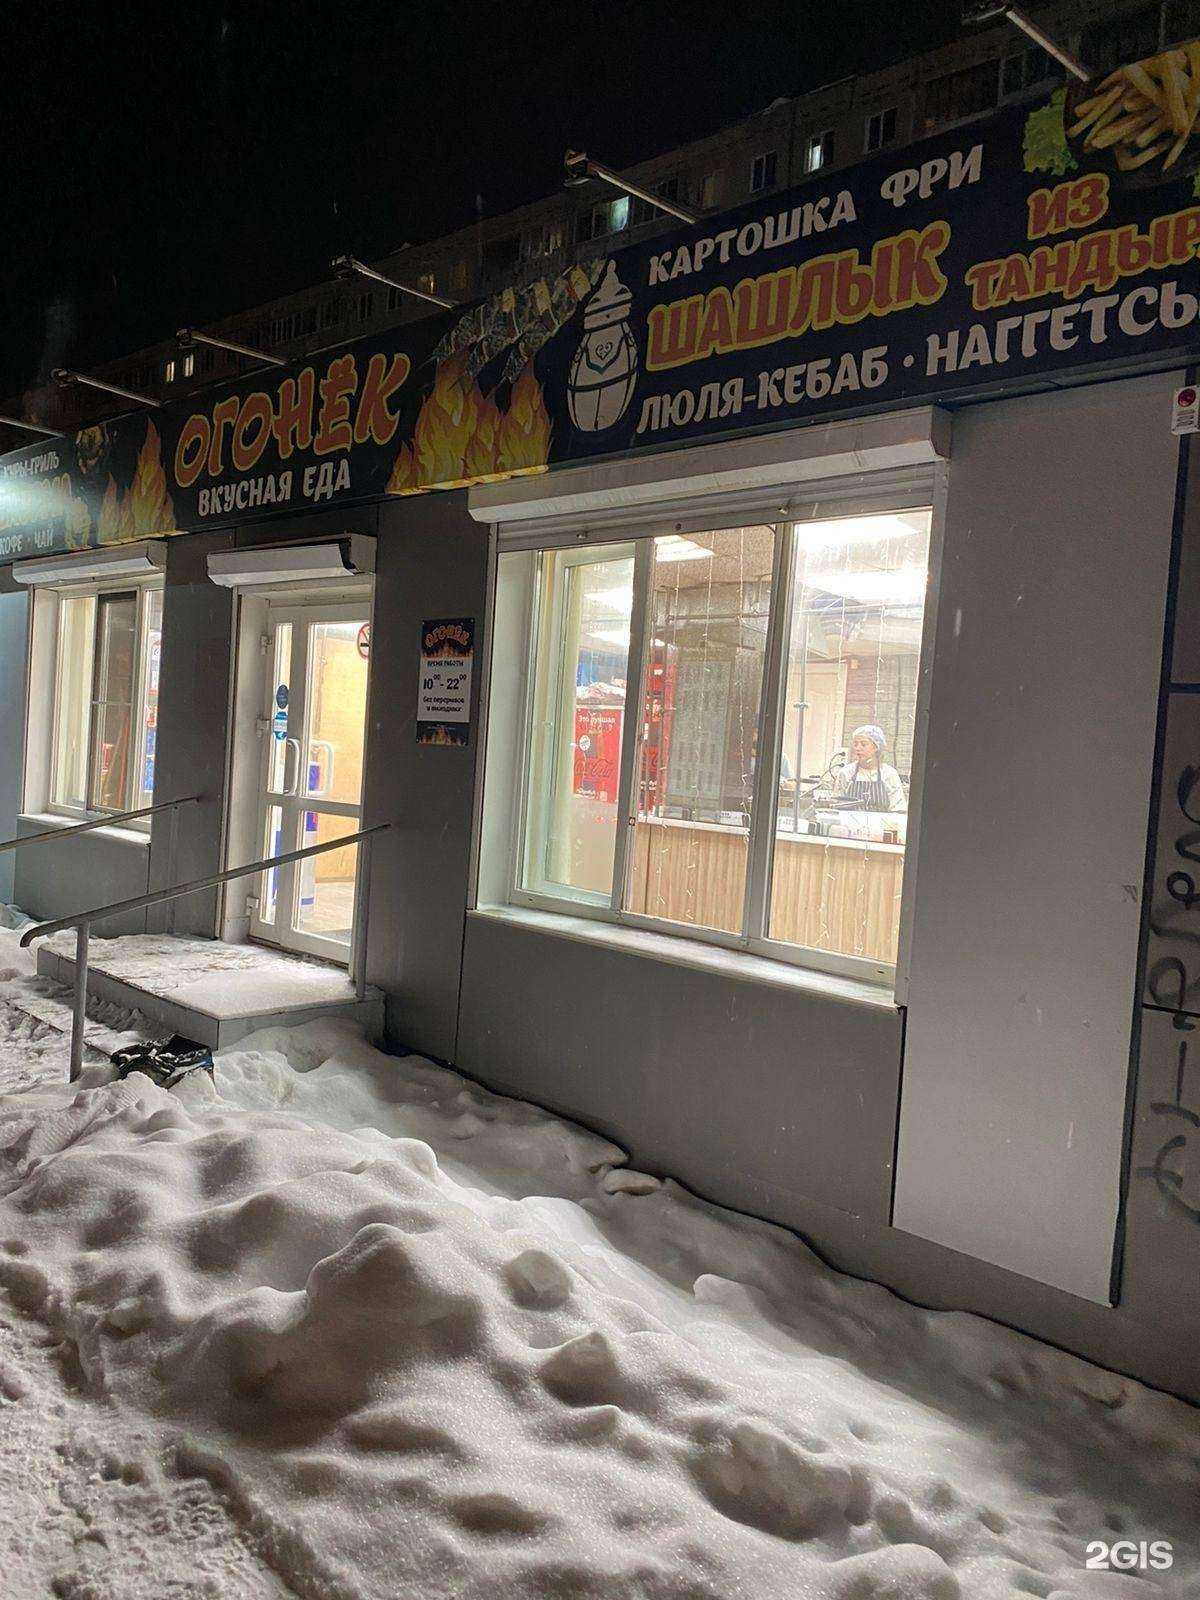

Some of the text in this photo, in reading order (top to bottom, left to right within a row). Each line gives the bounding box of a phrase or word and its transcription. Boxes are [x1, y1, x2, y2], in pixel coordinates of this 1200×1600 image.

[648, 144, 983, 286] КАРТОШКА ФРИ
[1027, 173, 1109, 240] ИЗ
[646, 220, 951, 372] ШАШЛЫК
[965, 206, 1200, 311] ТАНДЫР
[636, 346, 888, 434] ЛЮЛЯ-КЕБАБ
[198, 458, 350, 516] ВКУСНАЯ ЕДА
